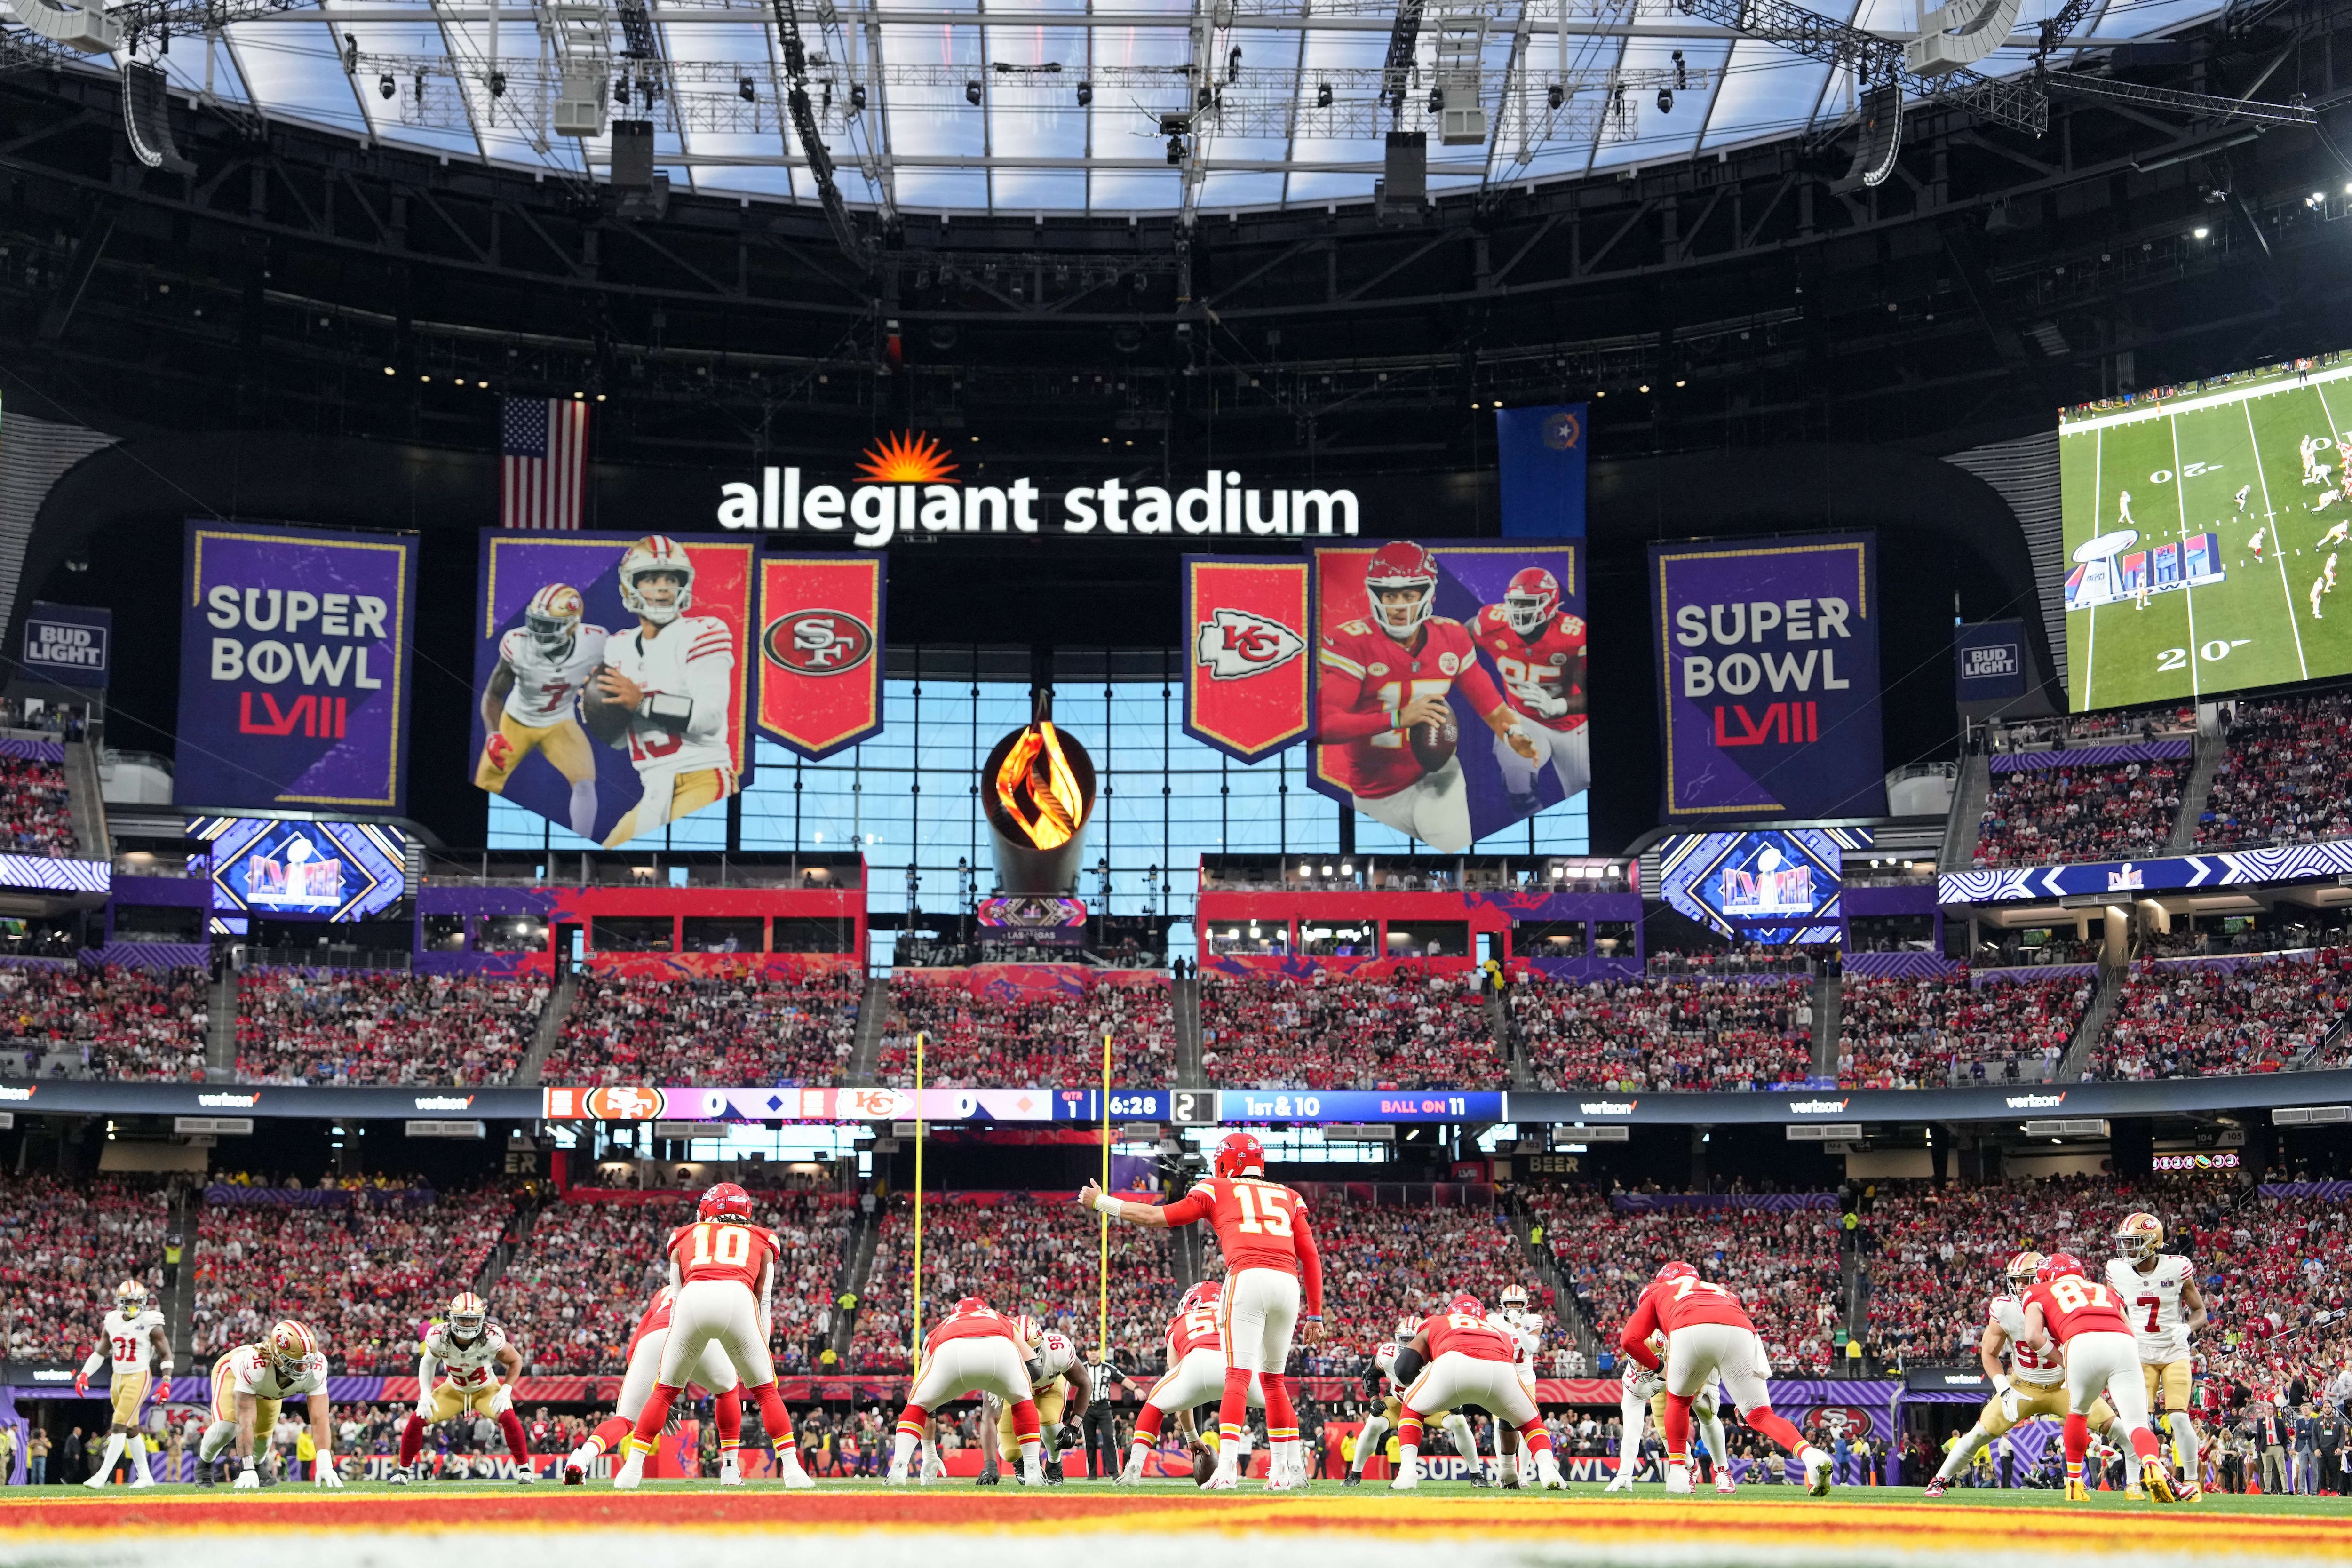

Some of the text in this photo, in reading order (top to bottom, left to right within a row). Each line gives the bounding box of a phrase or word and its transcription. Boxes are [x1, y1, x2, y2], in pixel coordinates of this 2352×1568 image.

[716, 466, 1359, 547] allegiant stadium
[207, 585, 388, 638] SUPER
[1676, 597, 1851, 647] SUPER
[40, 626, 91, 645] BUD
[794, 618, 854, 667] SF
[1222, 625, 1280, 661] KC
[29, 641, 100, 665] LIGHT
[211, 637, 382, 689] BOWL
[1971, 647, 2008, 662] BUD
[1684, 648, 1850, 698] BOWL
[1964, 658, 2015, 676] LIGHT
[538, 683, 570, 713] 7
[239, 692, 347, 739] LVIII
[1715, 701, 1818, 747] LVIII
[198, 1092, 254, 1107] verizon
[415, 1096, 468, 1110] verizon
[702, 1092, 728, 1117] 0
[855, 1091, 903, 1115] KC
[953, 1091, 977, 1118] 0
[1062, 1091, 1083, 1101] QTR
[1109, 1096, 1156, 1114] 6:28
[1177, 1094, 1195, 1121] 2
[1295, 1097, 1320, 1116] 10
[1381, 1098, 1465, 1115] BALL ON 11
[1580, 1101, 1631, 1114] verizon
[1790, 1100, 1843, 1114] verizon
[2006, 1094, 2060, 1108] verizon
[1068, 1101, 1076, 1118] 1
[1530, 1156, 1579, 1172] BEER
[1232, 1184, 1293, 1237] 15
[690, 1224, 750, 1268] 10
[2049, 1280, 2114, 1314] 87
[2245, 1301, 2254, 1310] 13
[2137, 1296, 2161, 1332] 7
[112, 1337, 136, 1362] 31
[446, 1365, 488, 1387] 54
[1945, 1374, 1982, 1384] verizon
